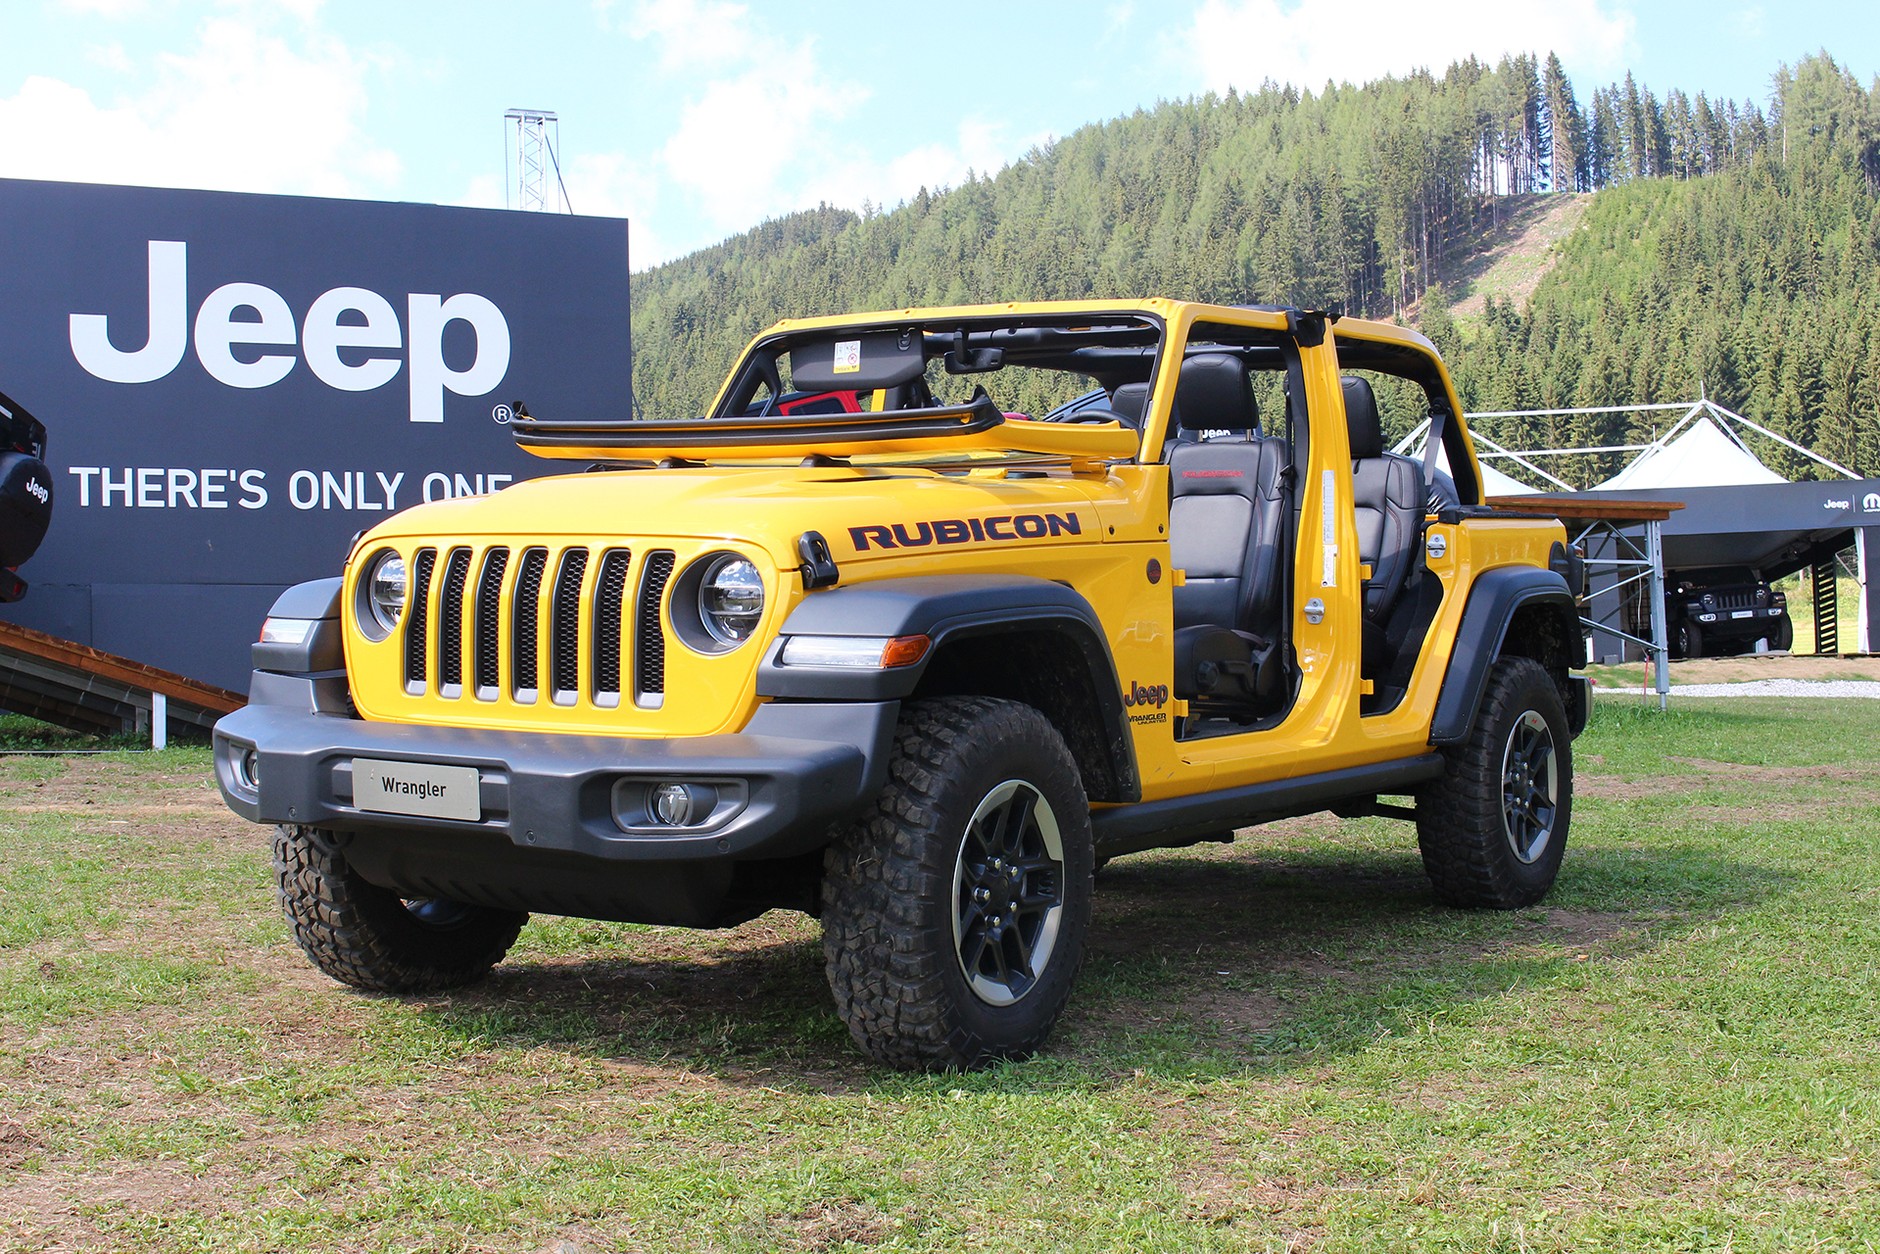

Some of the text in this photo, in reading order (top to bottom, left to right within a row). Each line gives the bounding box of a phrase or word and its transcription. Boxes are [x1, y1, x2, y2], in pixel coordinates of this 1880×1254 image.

[69, 239, 511, 423] Jeep
[26, 476, 49, 504] Jeep
[68, 466, 269, 509] THERE'S
[288, 469, 405, 511] ONLY
[1823, 499, 1849, 510] Jeep
[847, 512, 1082, 552] RUBICON
[1124, 680, 1168, 709] Jeep
[381, 776, 447, 800] Wrangler
